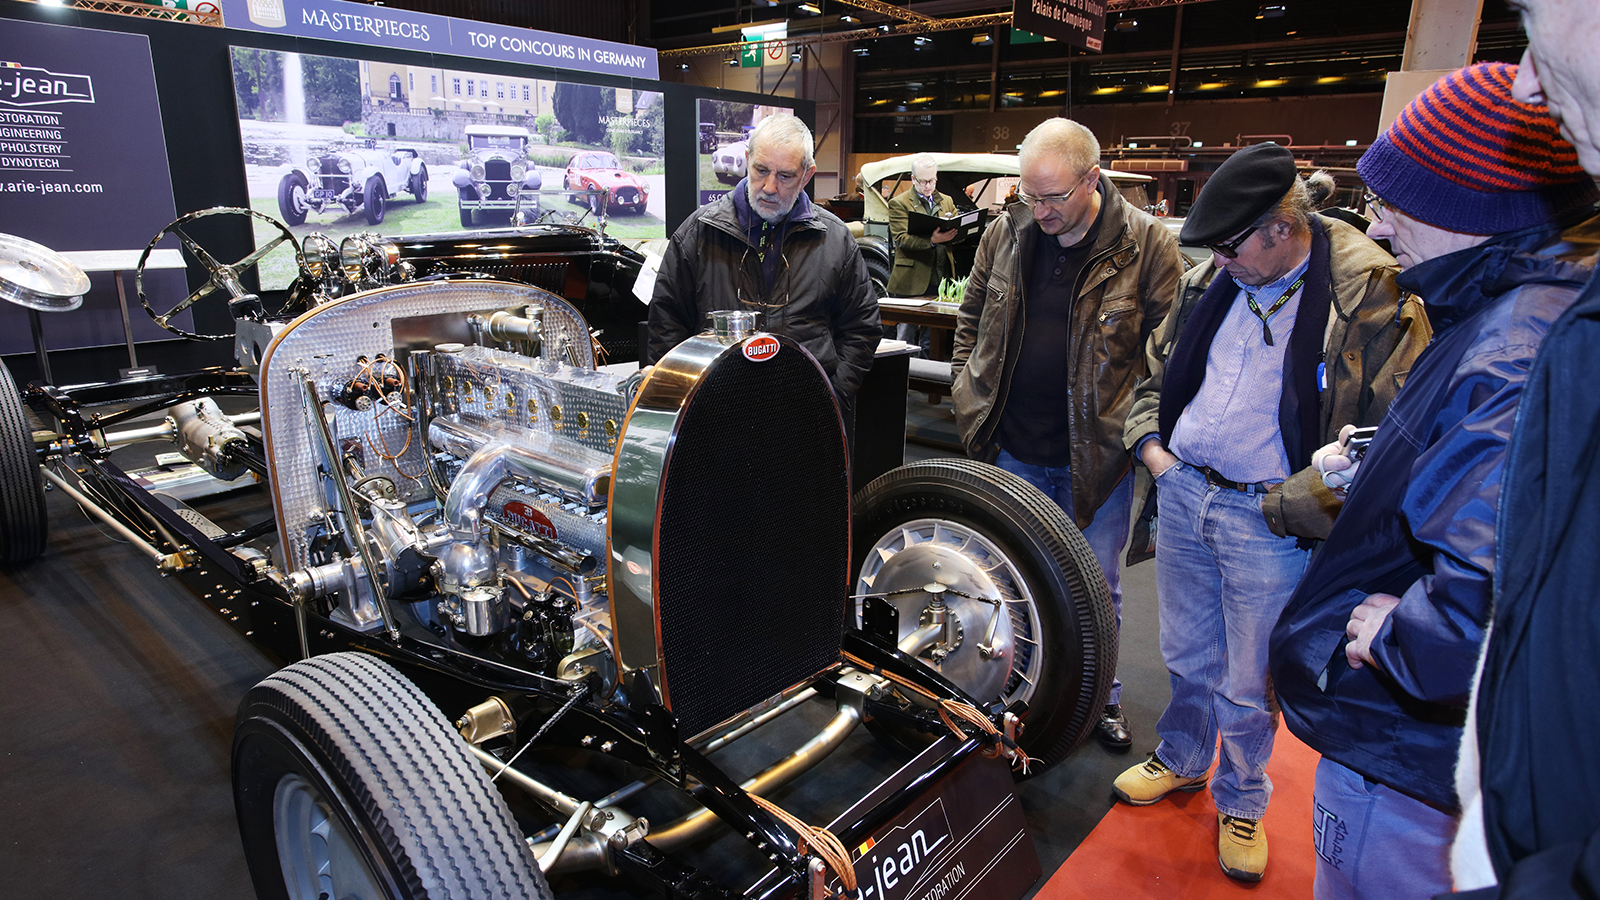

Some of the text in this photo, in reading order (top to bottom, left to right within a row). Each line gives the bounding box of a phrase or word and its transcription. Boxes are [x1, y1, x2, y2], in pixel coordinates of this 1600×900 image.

[1031, 0, 1053, 18] Palais
[1053, 5, 1062, 20] de
[302, 8, 430, 42] MASTERPIECES
[468, 31, 647, 69] TOP CONCOURS IN GERMANY
[598, 115, 651, 128] MASTERPIECES
[993, 126, 1010, 140] 38
[1170, 121, 1191, 137] 37
[0, 142, 62, 154] PHOLSTERY
[1, 157, 60, 168] DYNOTECH
[748, 343, 777, 356] BUGATTI
